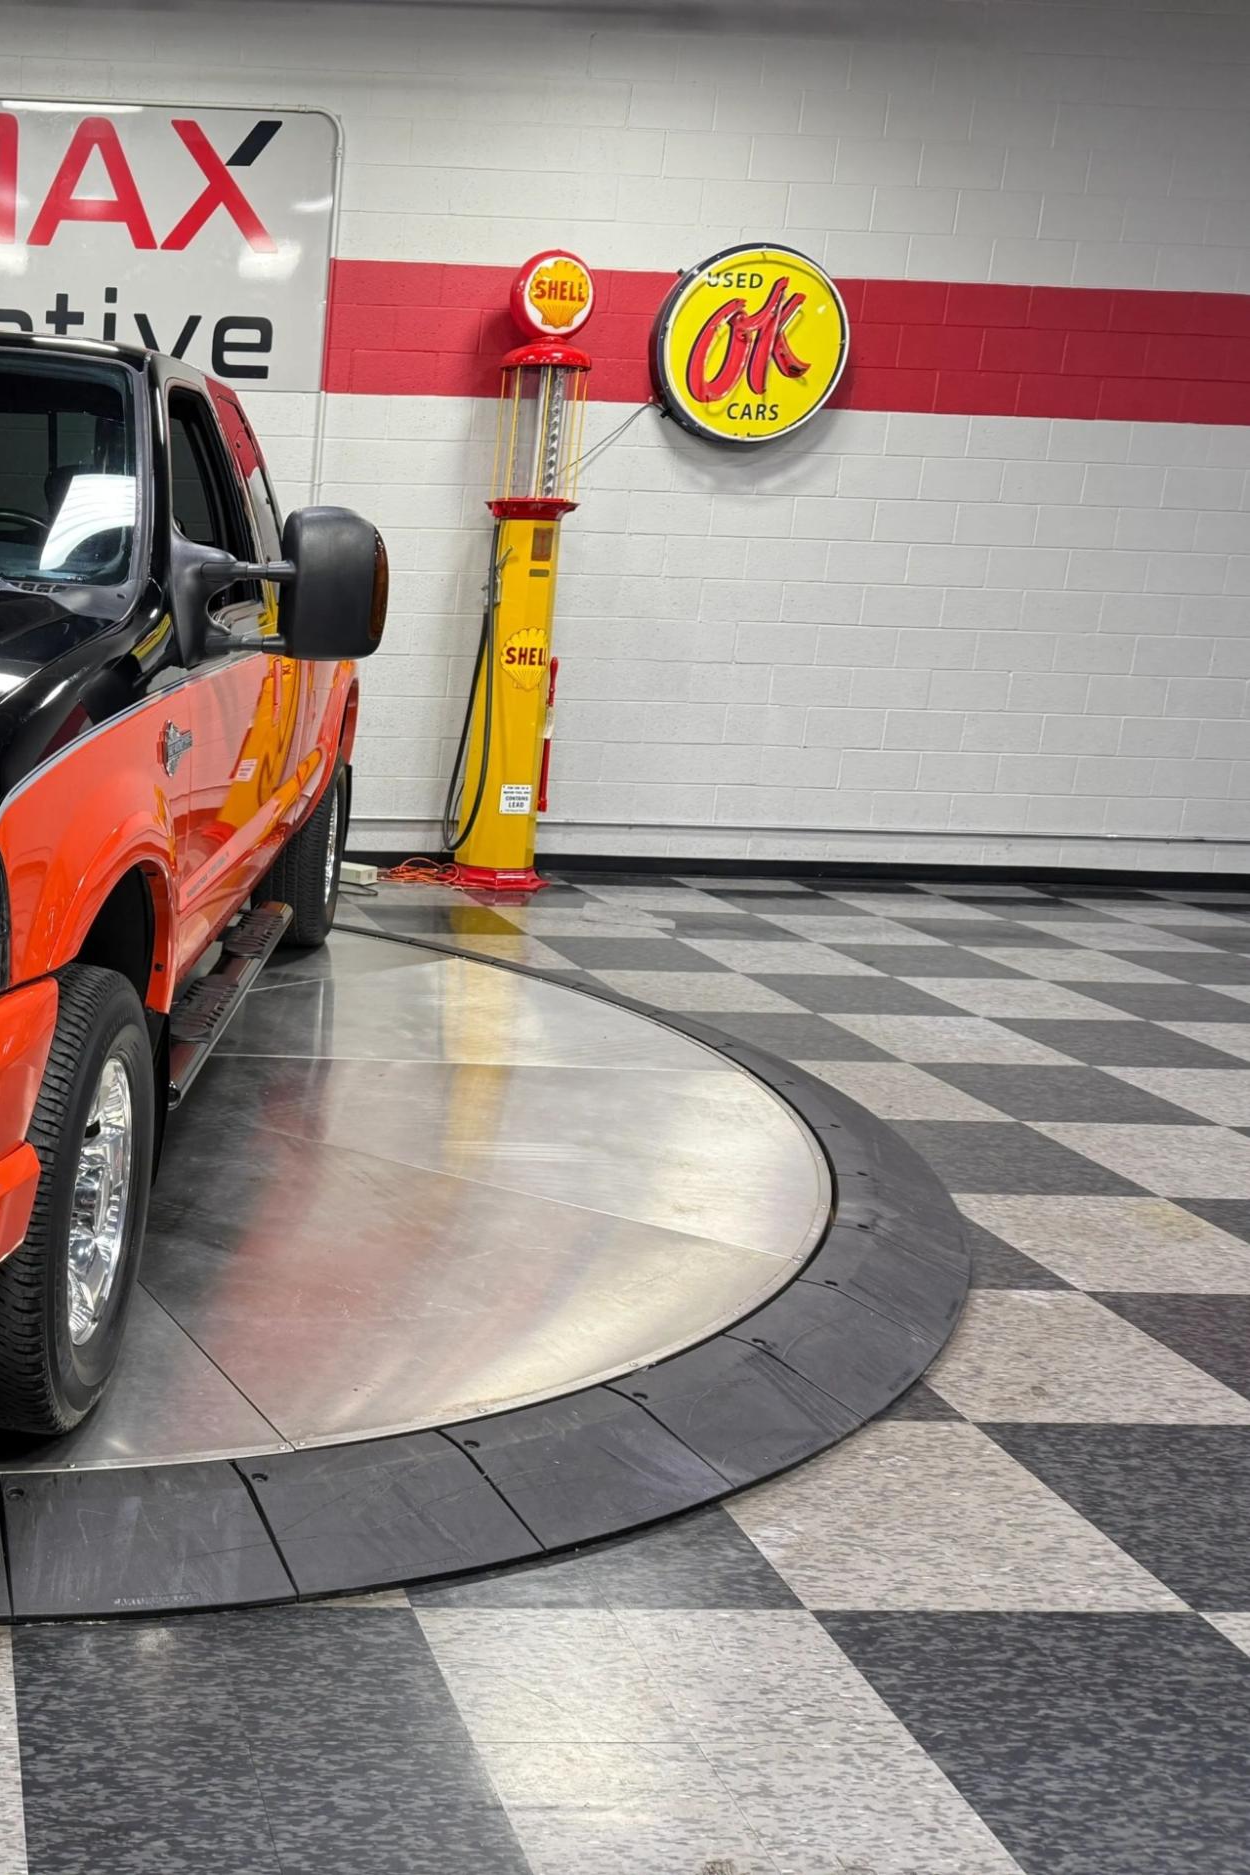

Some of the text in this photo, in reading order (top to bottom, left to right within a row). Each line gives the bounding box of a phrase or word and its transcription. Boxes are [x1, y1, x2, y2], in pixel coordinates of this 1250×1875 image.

[707, 272, 764, 289] USED
[533, 280, 586, 302] SHELL
[686, 276, 812, 403] OK
[727, 403, 779, 421] CARS
